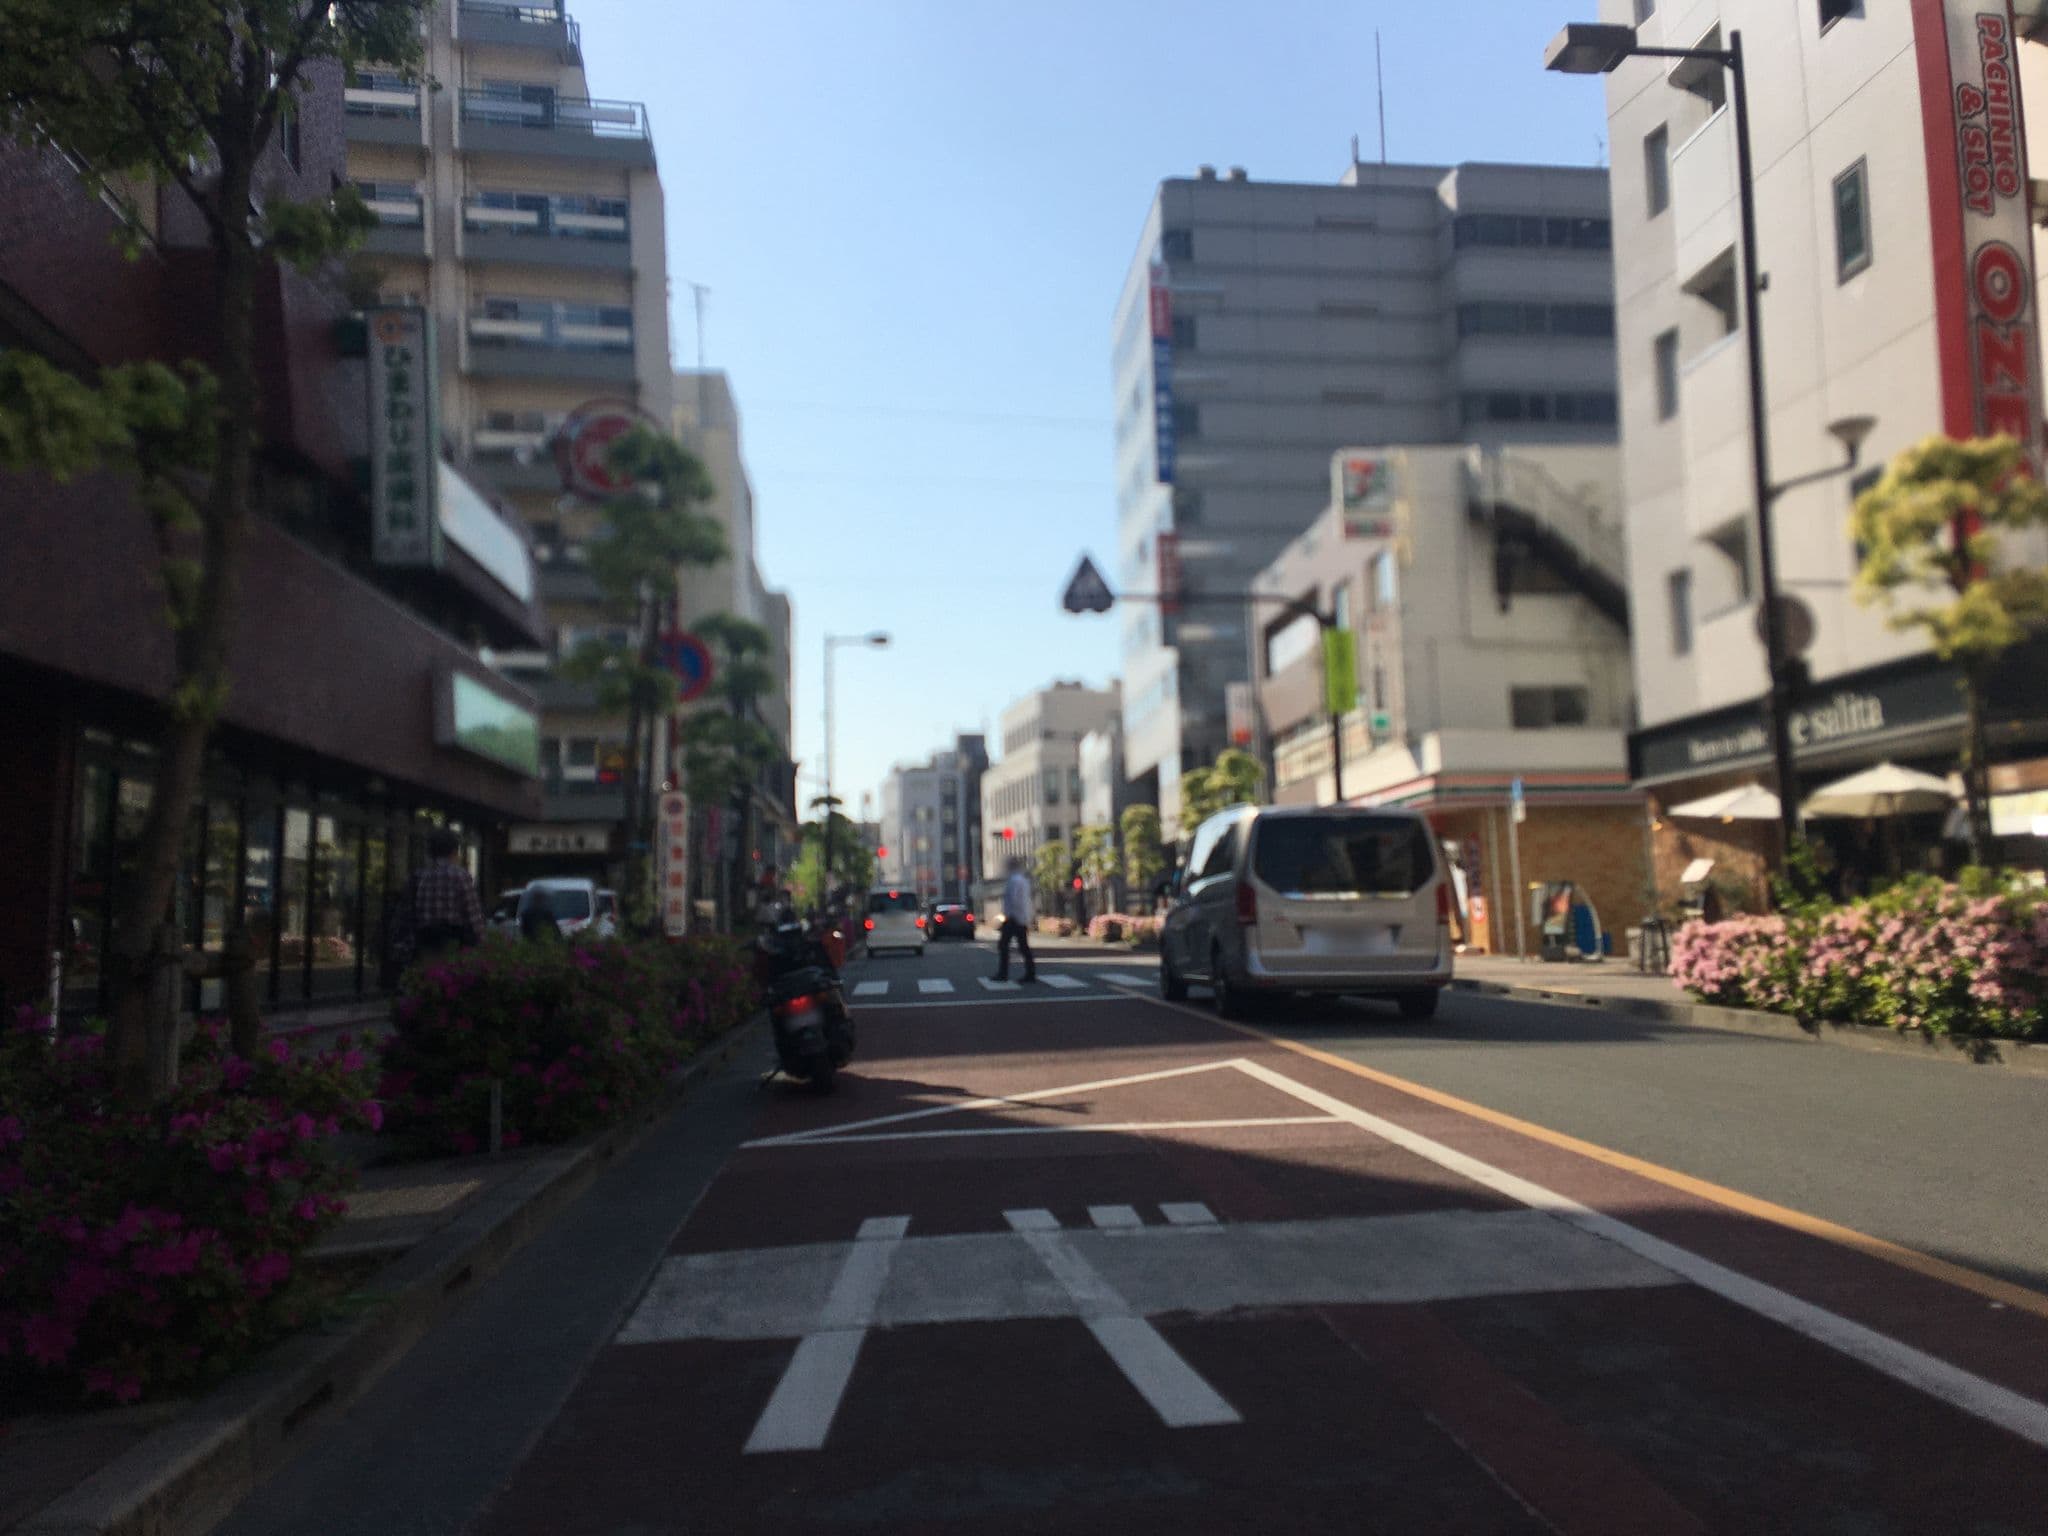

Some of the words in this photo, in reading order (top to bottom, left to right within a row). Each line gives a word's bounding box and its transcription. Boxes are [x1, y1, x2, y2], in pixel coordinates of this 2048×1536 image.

[1957, 83, 1984, 119] &
[1976, 13, 2020, 198] PACHINKO
[1962, 126, 1995, 217] SLOT
